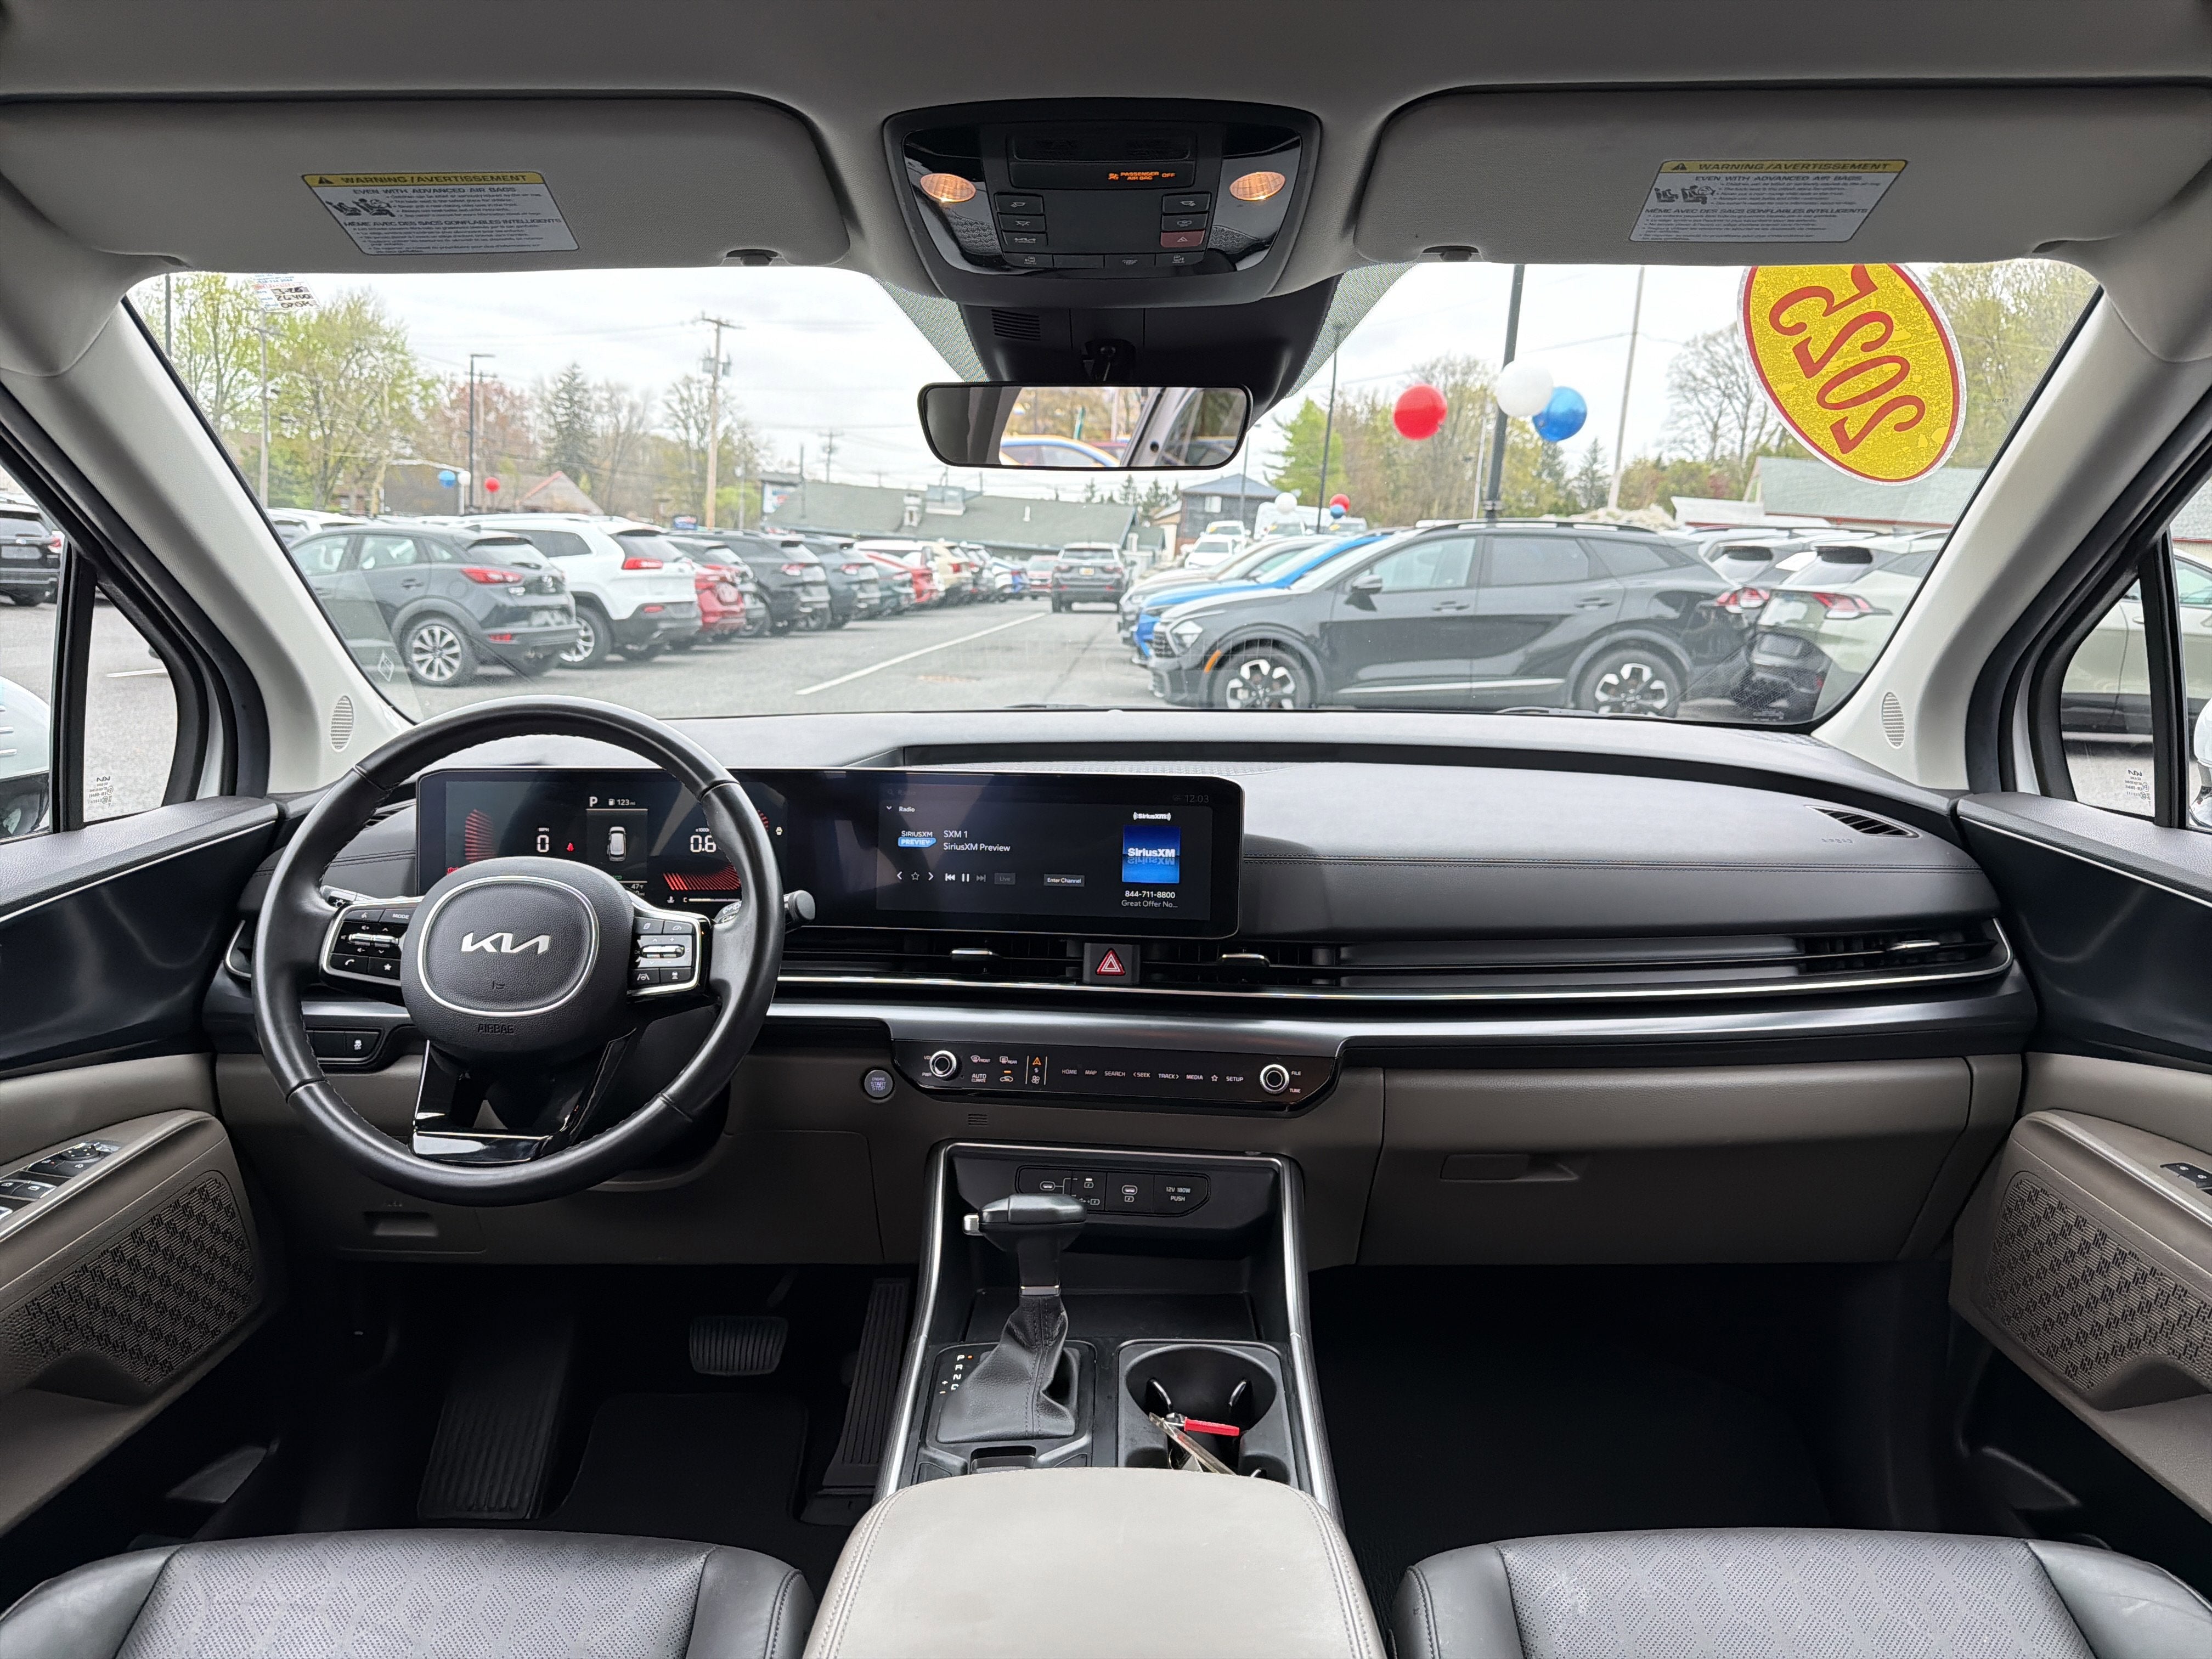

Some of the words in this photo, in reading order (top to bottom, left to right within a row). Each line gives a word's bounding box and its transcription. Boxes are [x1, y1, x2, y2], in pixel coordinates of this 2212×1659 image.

[589, 796, 598, 807] P
[537, 834, 549, 853] 0
[943, 842, 978, 850] SiriusXM
[979, 843, 1011, 851] Preview
[1127, 848, 1176, 857] SiriusXM
[1125, 890, 1176, 899] 844-711-8800
[461, 933, 550, 955] KIA
[477, 1023, 515, 1035] AIRBAG
